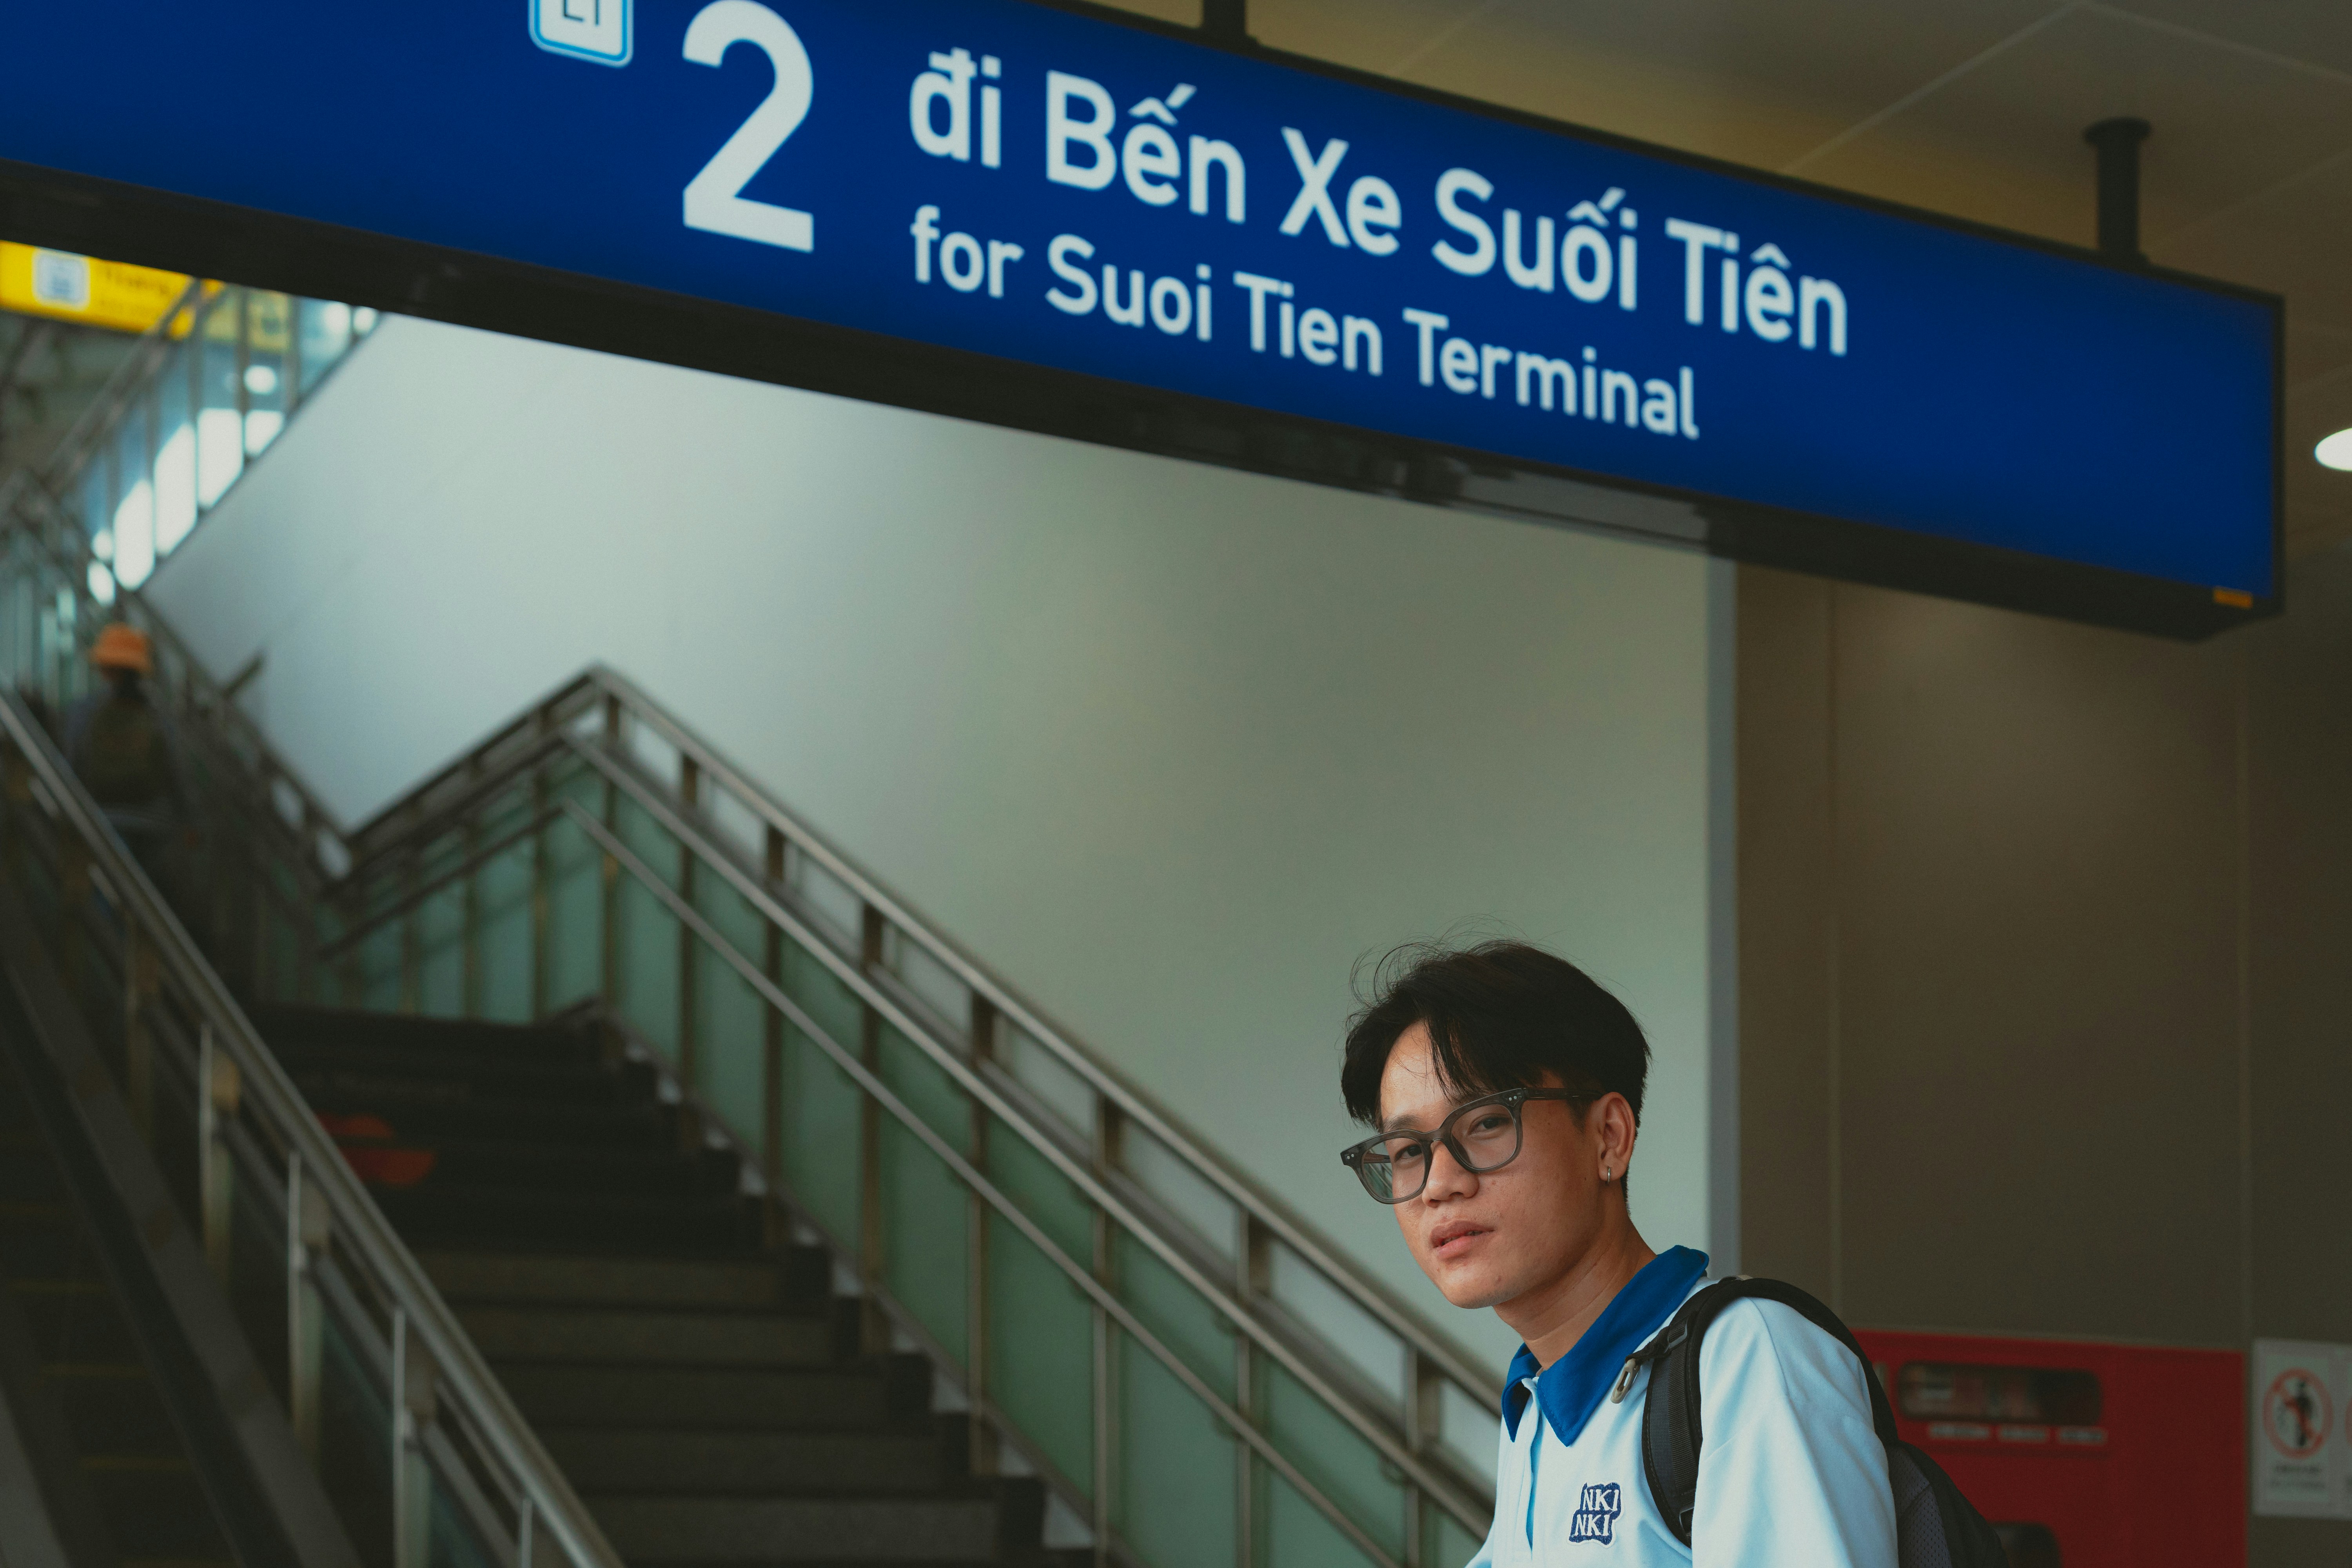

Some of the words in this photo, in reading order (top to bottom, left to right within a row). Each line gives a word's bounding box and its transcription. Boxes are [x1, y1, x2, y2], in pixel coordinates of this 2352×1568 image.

[682, 0, 813, 253] 2
[909, 47, 1000, 168] đi
[1046, 71, 1245, 223] Bến
[1280, 127, 1401, 255] Xe
[1432, 169, 1637, 310] Suối
[1666, 218, 1847, 355] Tiên
[910, 205, 1024, 298] for
[1046, 234, 1211, 341] Suoi
[1234, 271, 1382, 375] Tien
[1403, 308, 1699, 439] Terminal
